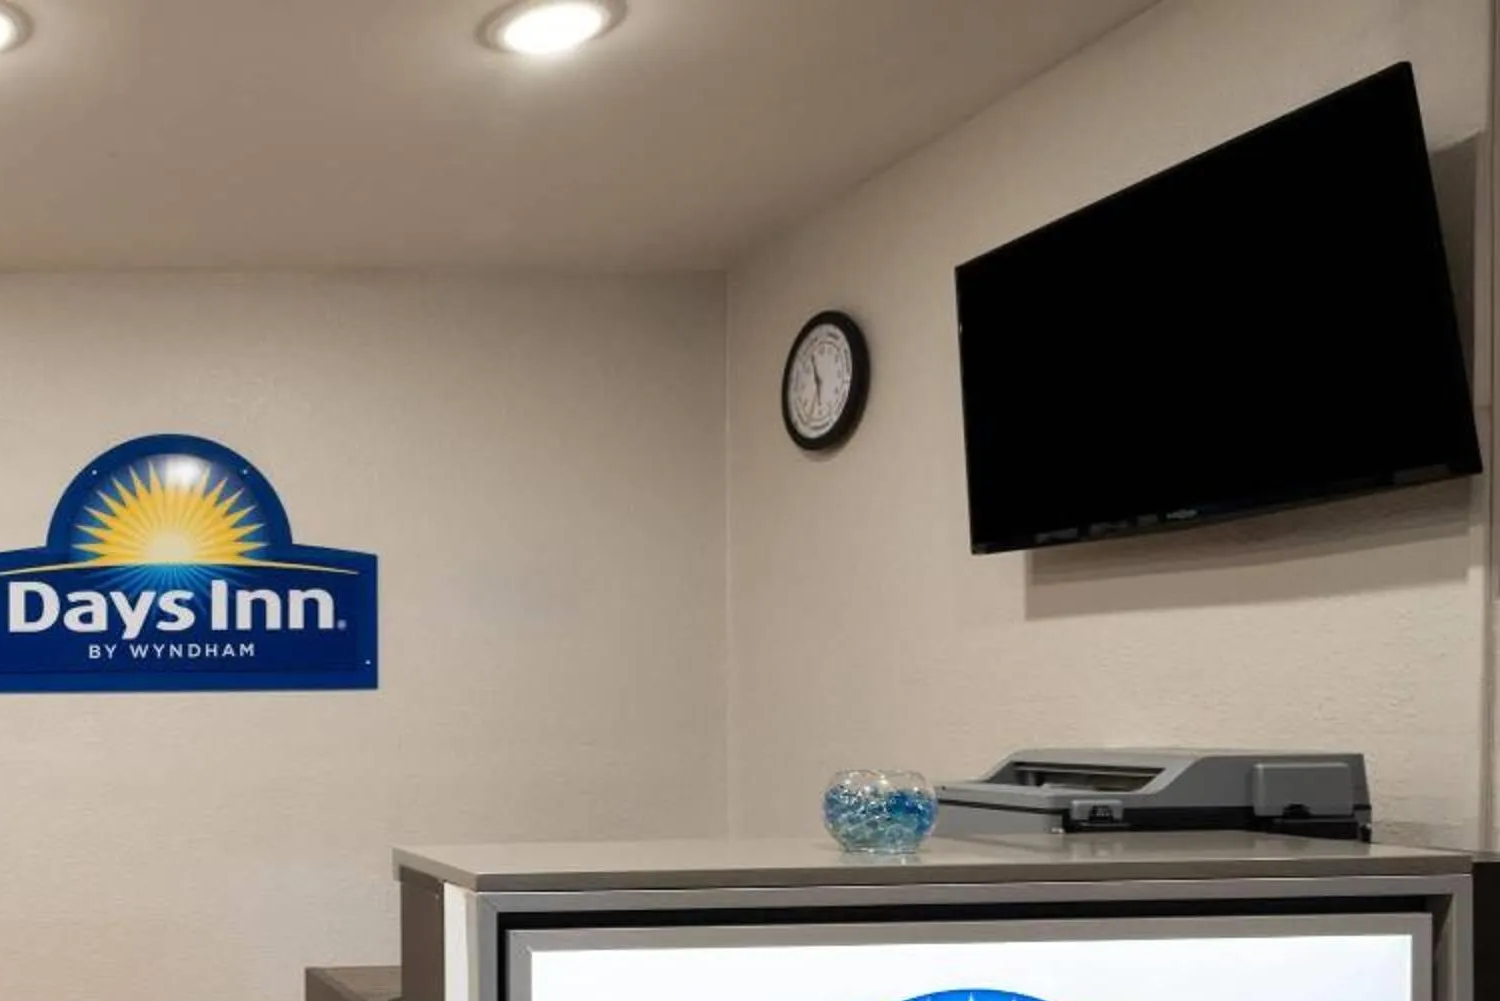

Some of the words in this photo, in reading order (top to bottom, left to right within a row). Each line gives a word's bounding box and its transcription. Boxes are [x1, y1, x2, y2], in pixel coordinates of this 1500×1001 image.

[8, 581, 196, 640] Days
[88, 644, 117, 660] BY
[129, 642, 255, 659] WYNDHAM
